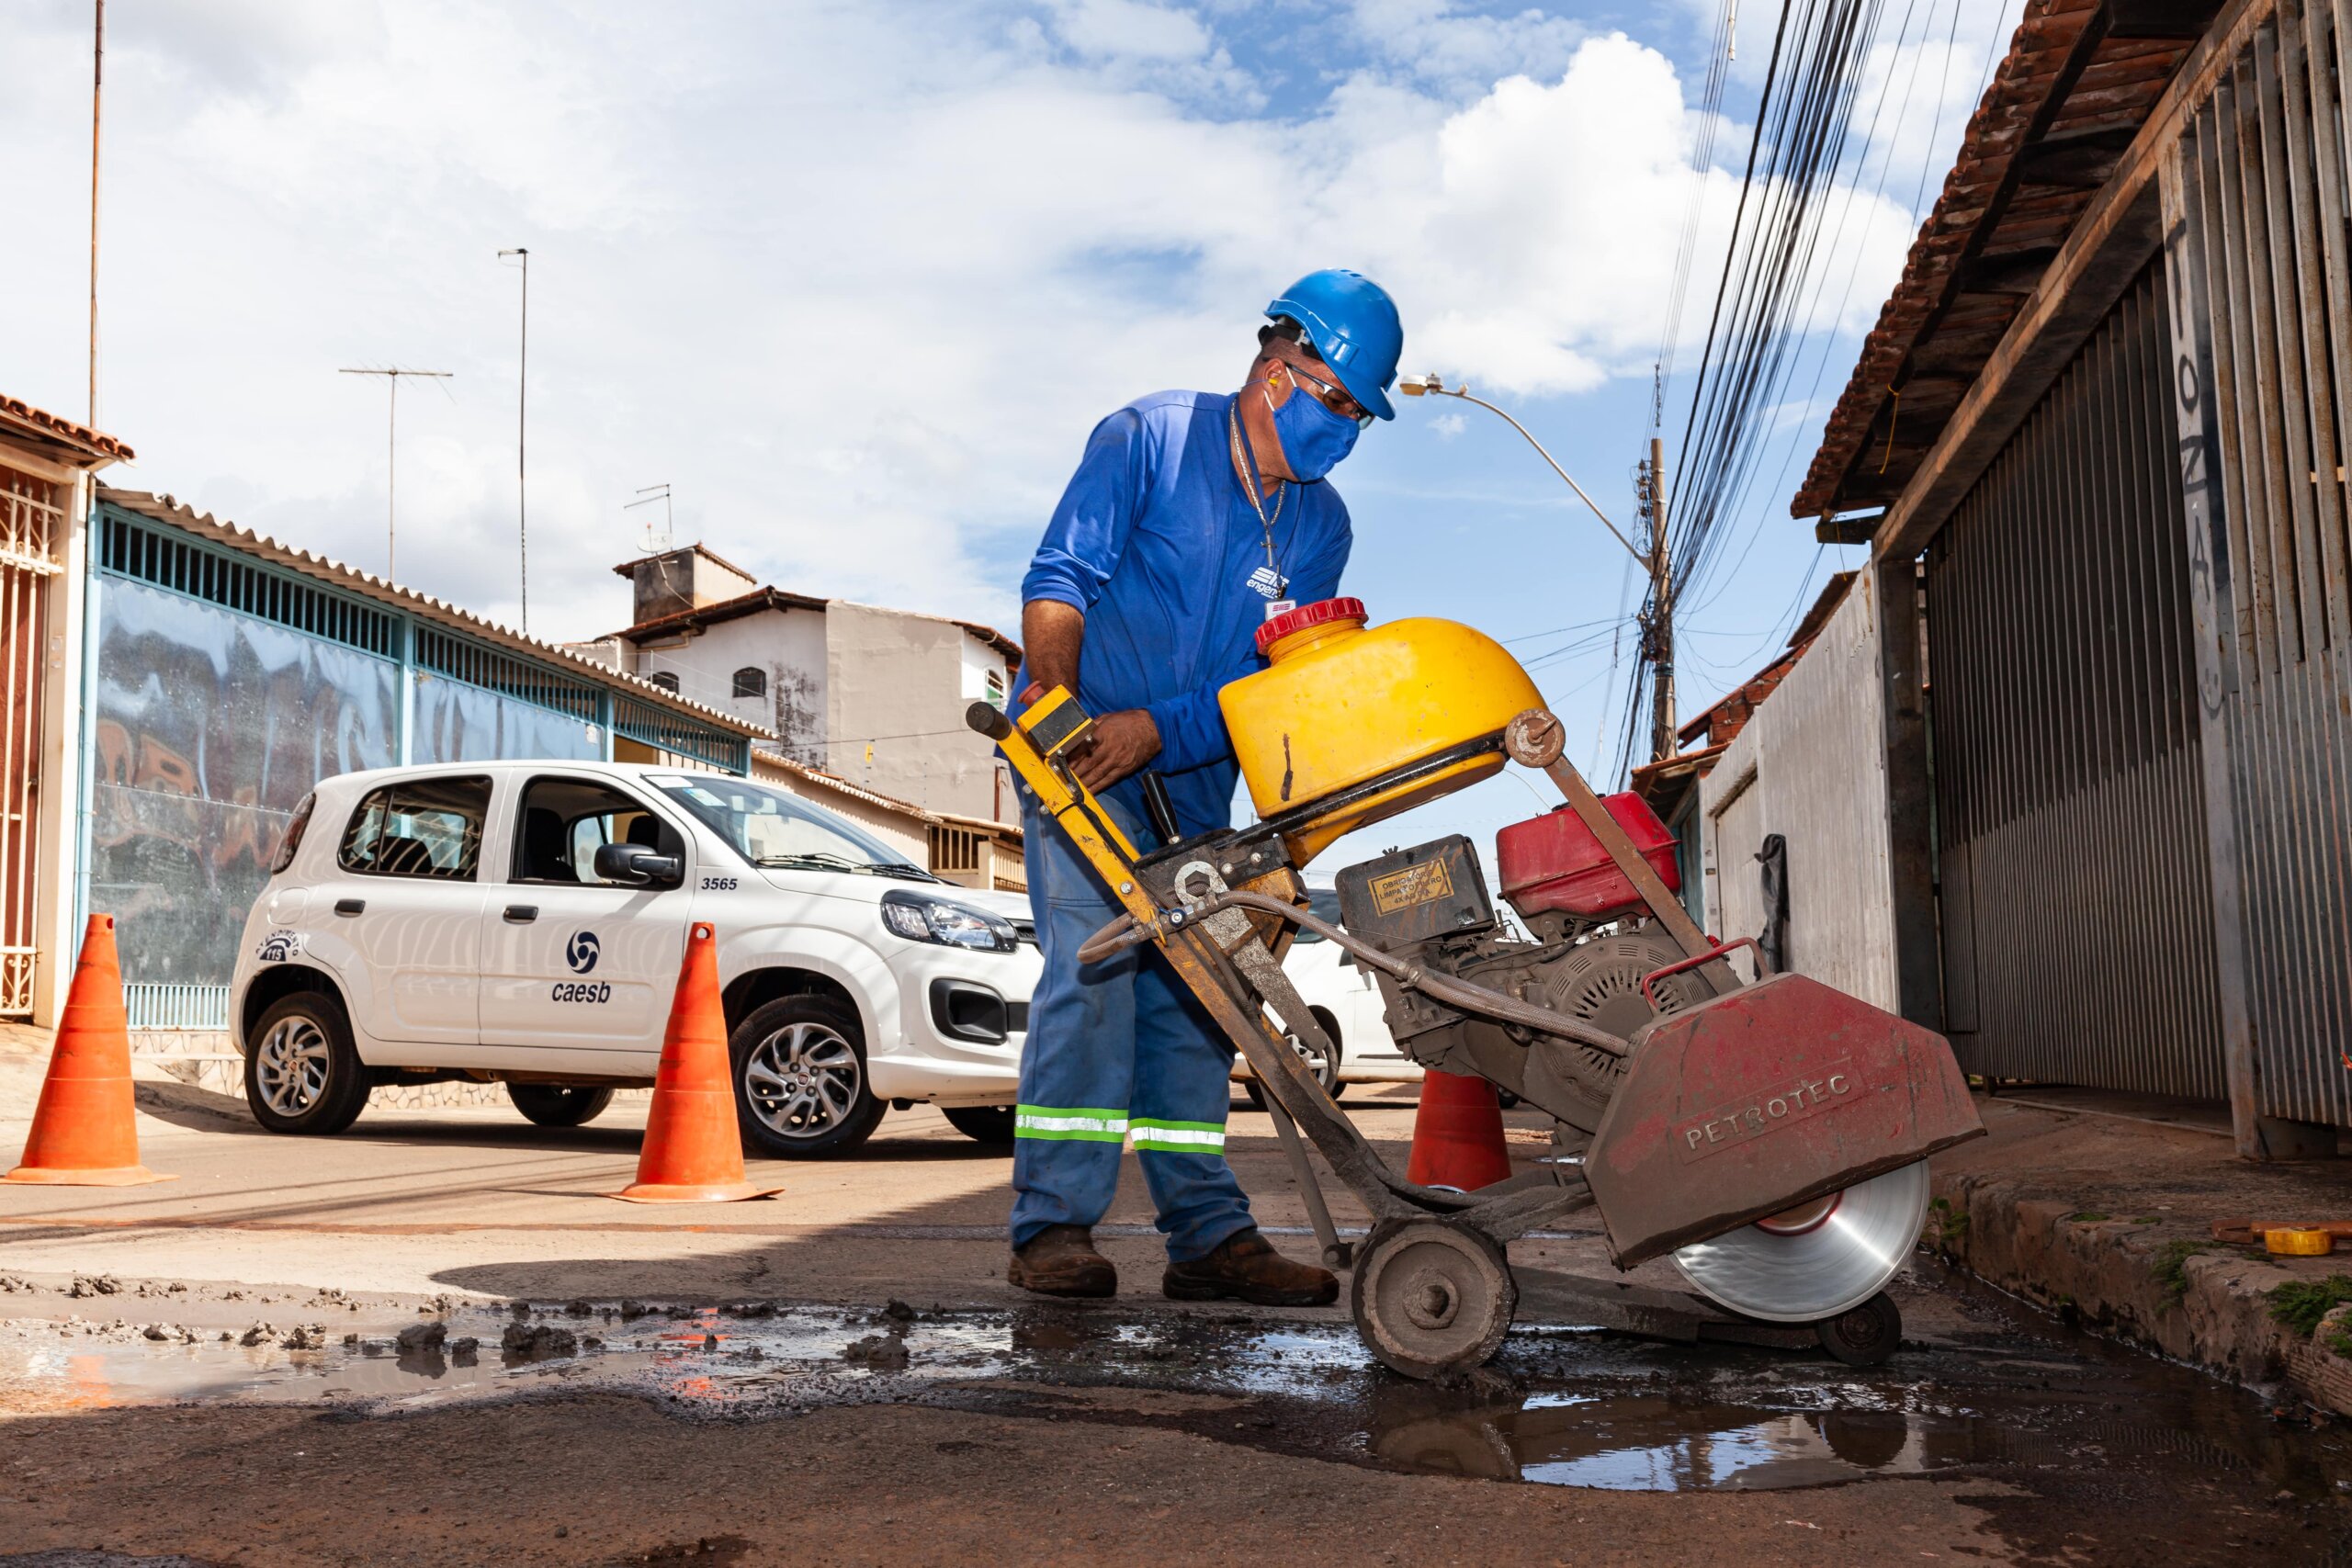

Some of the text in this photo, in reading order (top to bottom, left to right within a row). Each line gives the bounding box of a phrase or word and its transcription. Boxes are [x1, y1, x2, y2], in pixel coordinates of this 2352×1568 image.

[701, 877, 738, 890] 3565
[266, 948, 282, 961] 115
[552, 980, 611, 1004] caesb
[1685, 1075, 1850, 1150] PETROTEC
